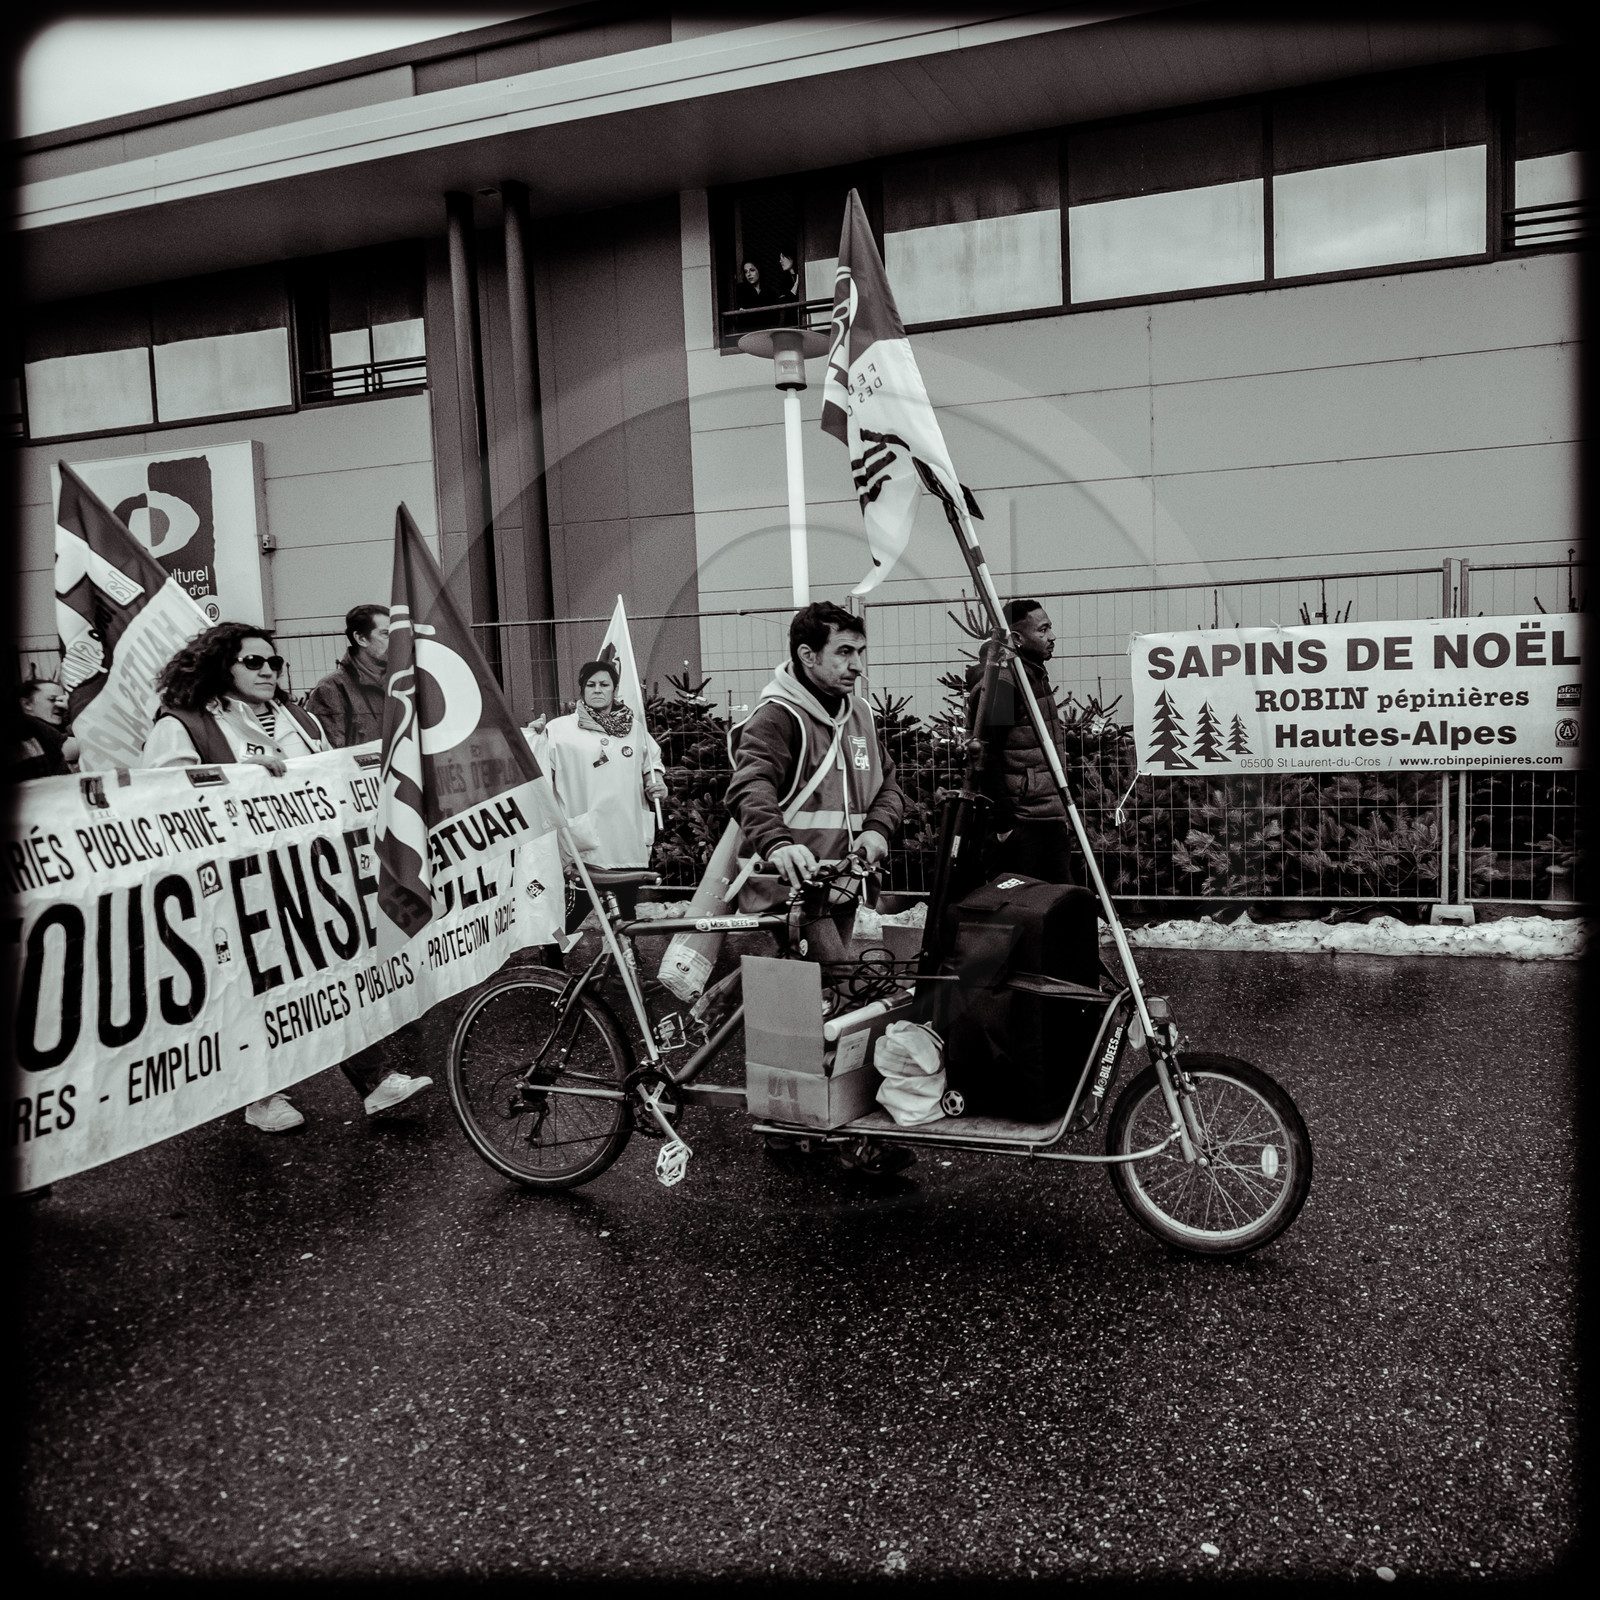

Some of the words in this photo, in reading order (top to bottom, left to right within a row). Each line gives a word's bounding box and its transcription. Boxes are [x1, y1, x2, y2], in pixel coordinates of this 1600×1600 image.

[1147, 638, 1328, 680] SAPINS
[1347, 635, 1413, 672] DE
[1433, 621, 1582, 669] NOËL
[1254, 686, 1369, 713] ROBIN
[1377, 687, 1530, 714] pépinières
[1240, 757, 1274, 769] 05500
[1277, 757, 1288, 768] St
[1291, 756, 1381, 768] Laurent-du-Cros
[1399, 755, 1563, 767] www.robinpepinieres.com
[1275, 720, 1517, 750] Hautes-Alpes
[75, 794, 227, 873] PUBLIC/PRIVÉ
[241, 780, 337, 836] RETRAITÉS
[8, 872, 208, 1073] OUS
[129, 1031, 222, 1106] EMPLOI
[264, 980, 351, 1050] SERVICES
[355, 952, 415, 1008] PUBLICS
